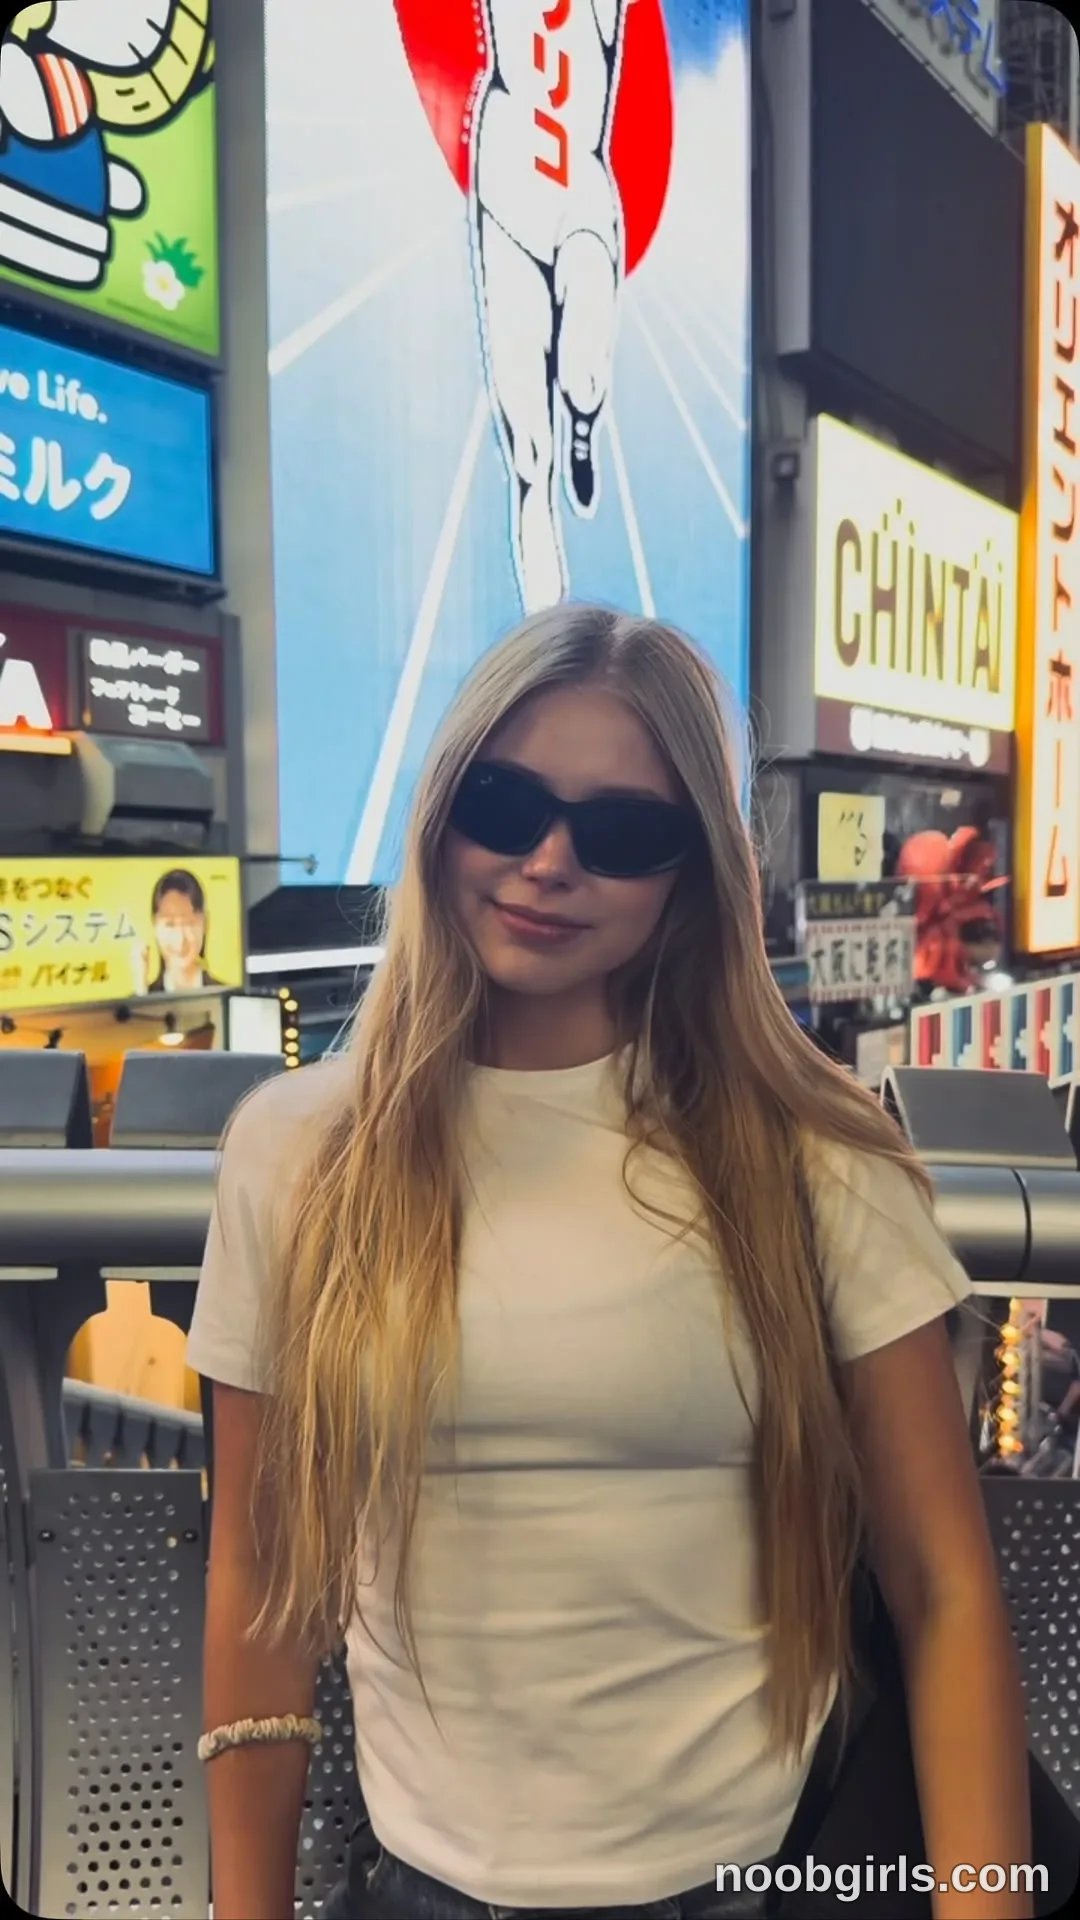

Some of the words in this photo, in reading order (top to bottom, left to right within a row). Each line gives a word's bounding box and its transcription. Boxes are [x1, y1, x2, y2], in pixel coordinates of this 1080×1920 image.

[37, 368, 108, 424] Life.
[835, 498, 1002, 694] CHINTAI
[1045, 199, 1079, 897] オリエントホーム
[0, 632, 54, 729] A
